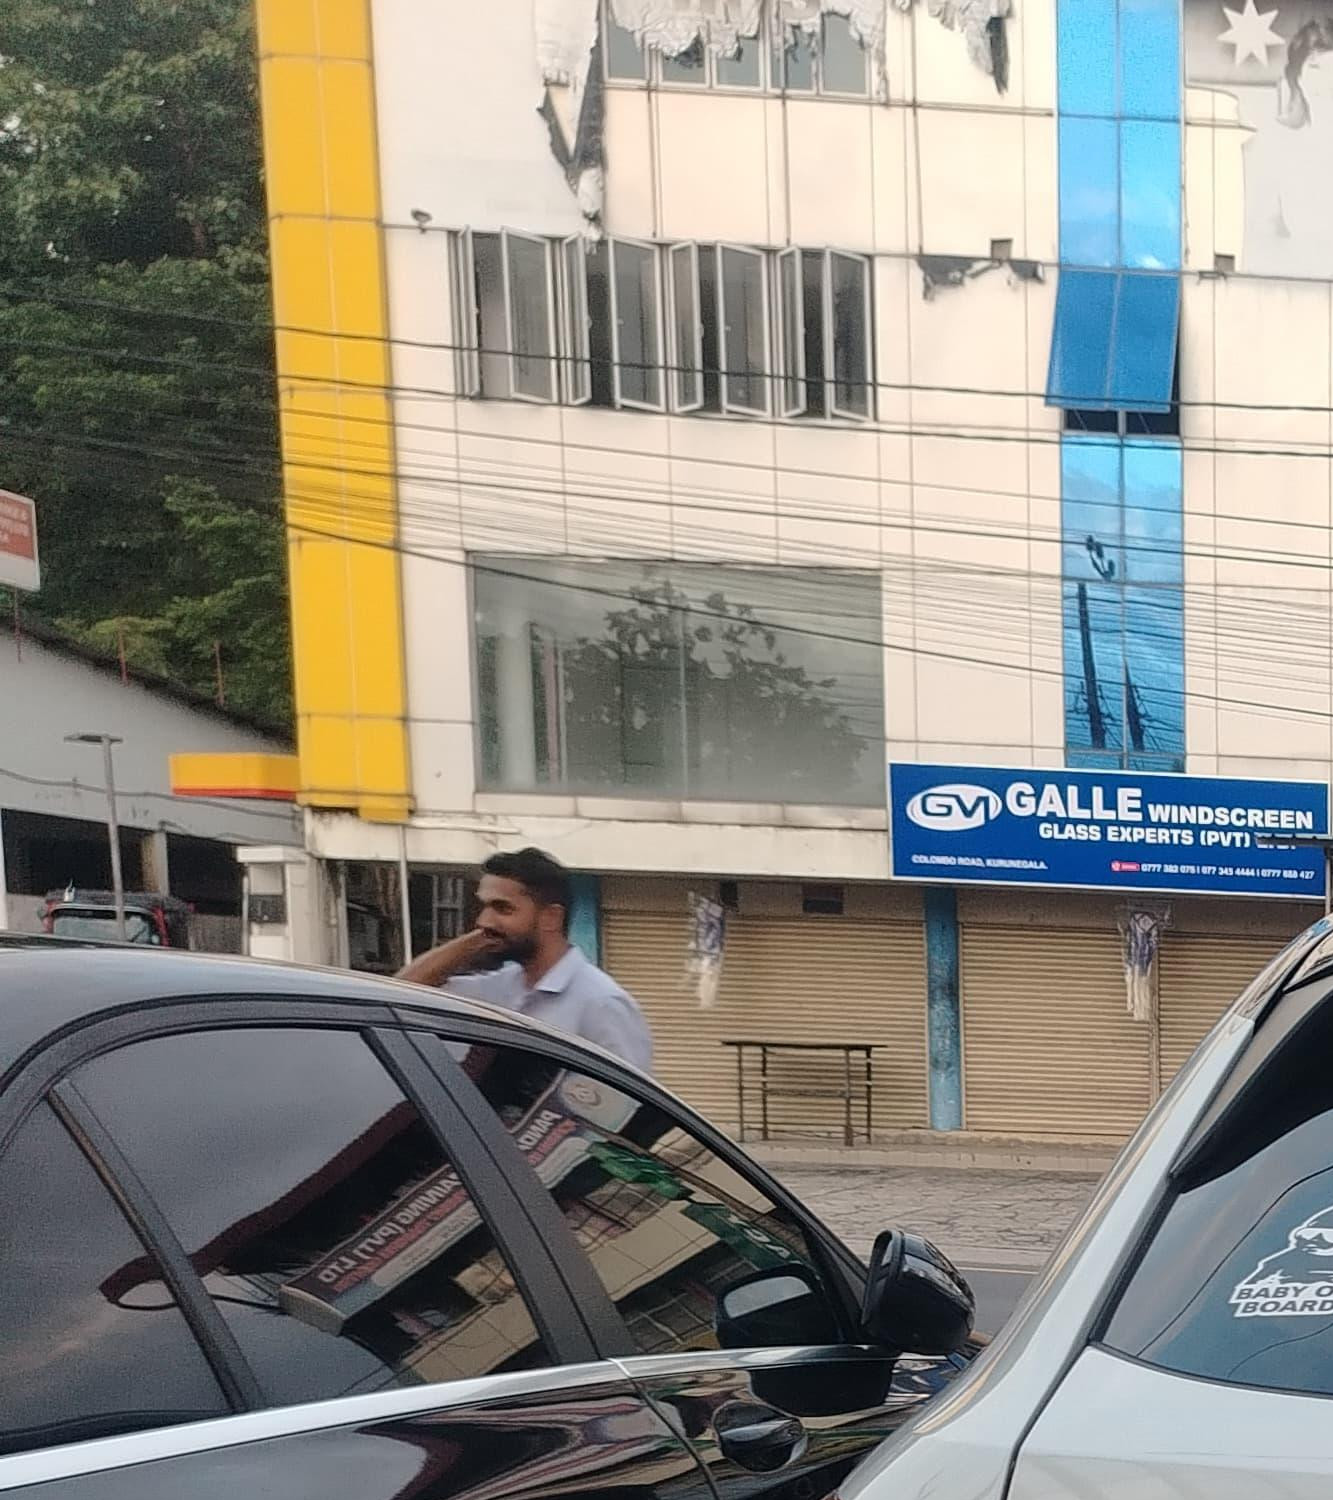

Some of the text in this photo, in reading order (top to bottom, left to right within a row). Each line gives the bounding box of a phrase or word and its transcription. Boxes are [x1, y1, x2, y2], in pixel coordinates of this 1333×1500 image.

[1005, 781, 1143, 822] GALLE
[1148, 804, 1313, 830] WINDSCREEN
[1039, 824, 1101, 843] GLASS
[1107, 826, 1194, 846] EXPERTS
[1200, 830, 1251, 848] (PVT)
[1236, 1285, 1307, 1301] BABY
